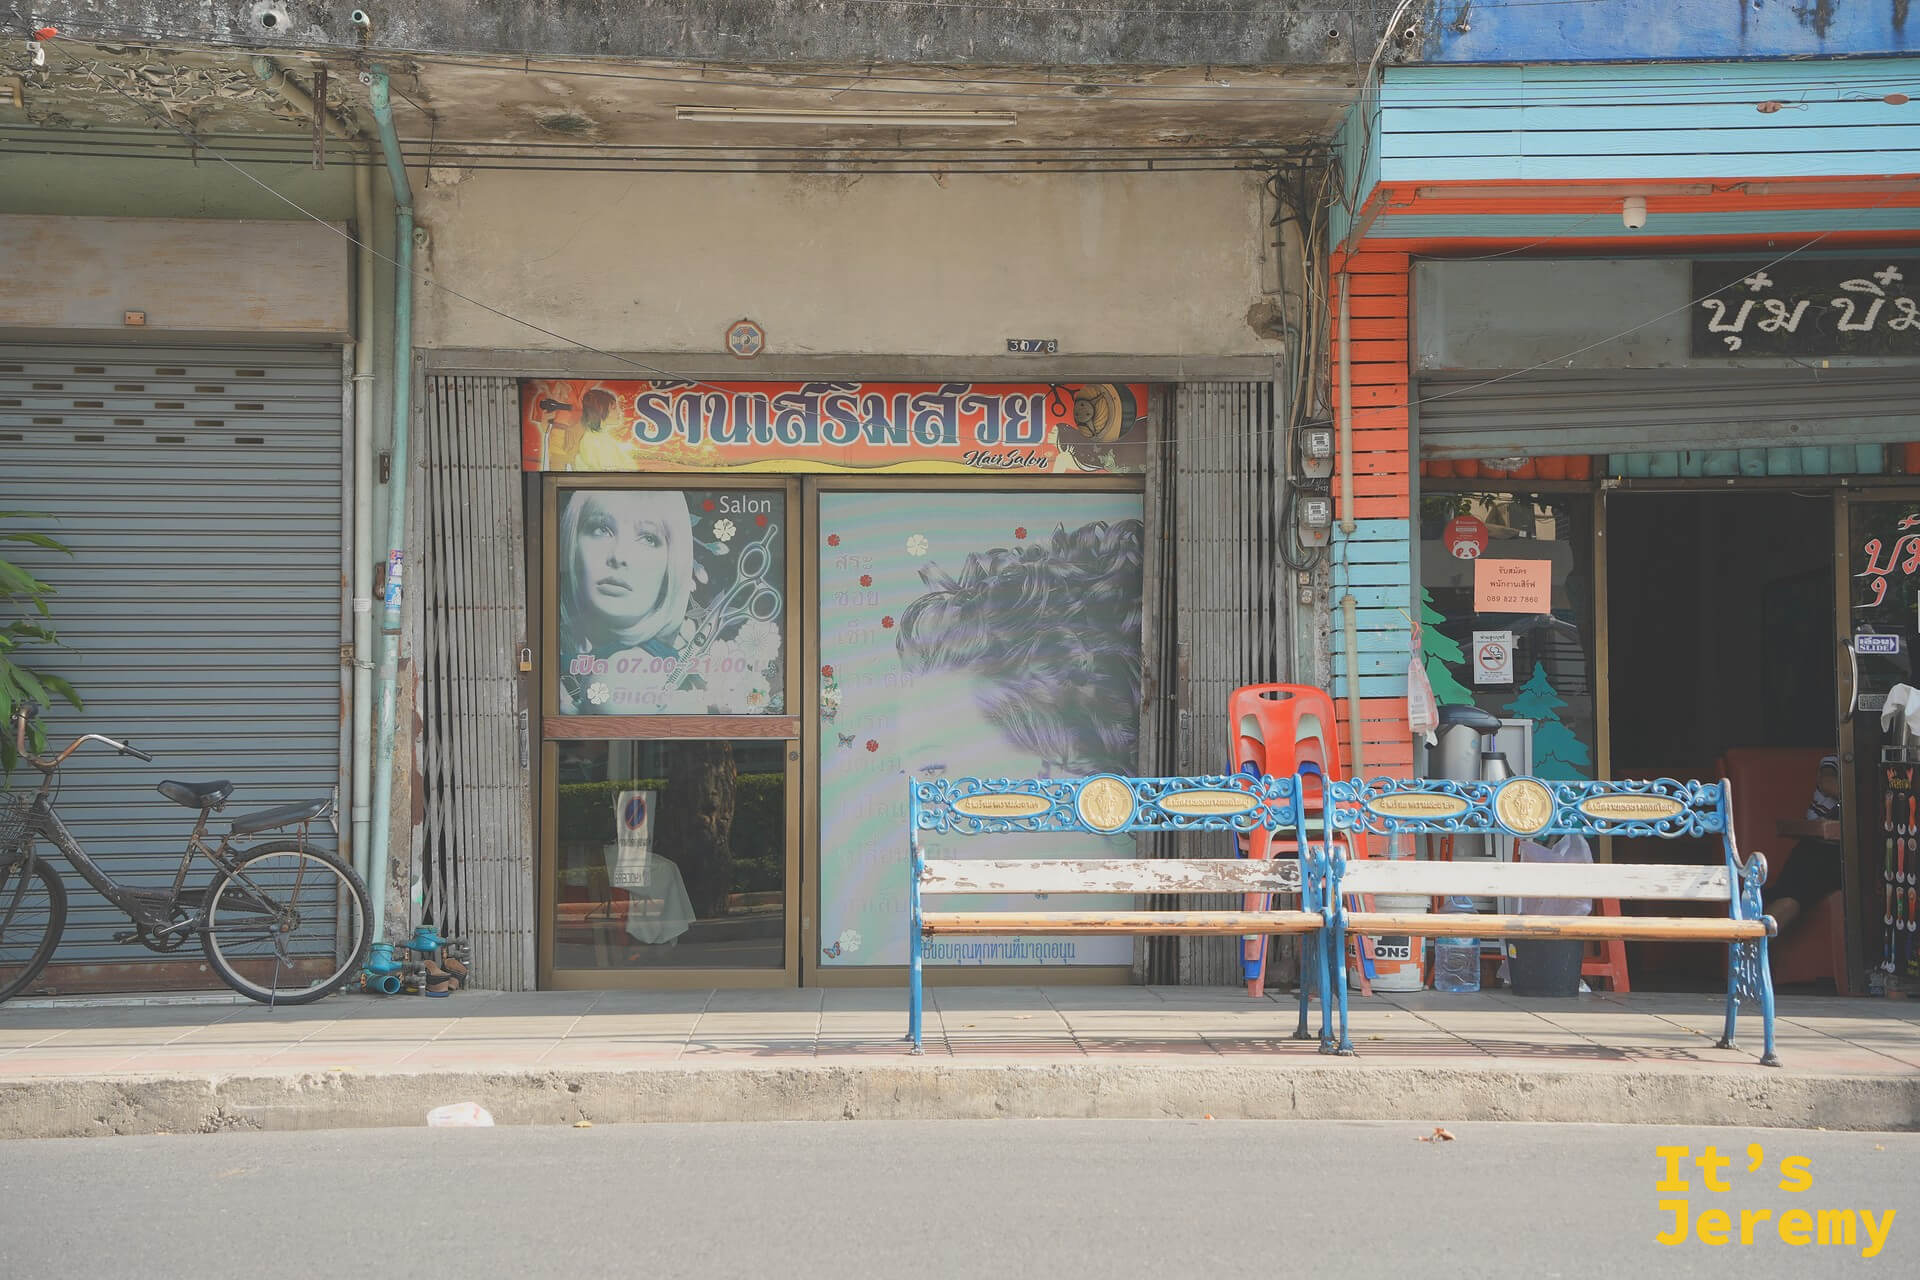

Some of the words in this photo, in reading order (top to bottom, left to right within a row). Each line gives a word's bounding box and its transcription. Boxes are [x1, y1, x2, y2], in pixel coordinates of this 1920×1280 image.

[635, 381, 1046, 446] ร้านเสริมสวย
[963, 450, 1003, 467] Hair
[1002, 448, 1048, 468] Salon
[719, 495, 771, 514] Salon
[1859, 644, 1890, 652] SLIDE
[569, 655, 608, 674] เปิด
